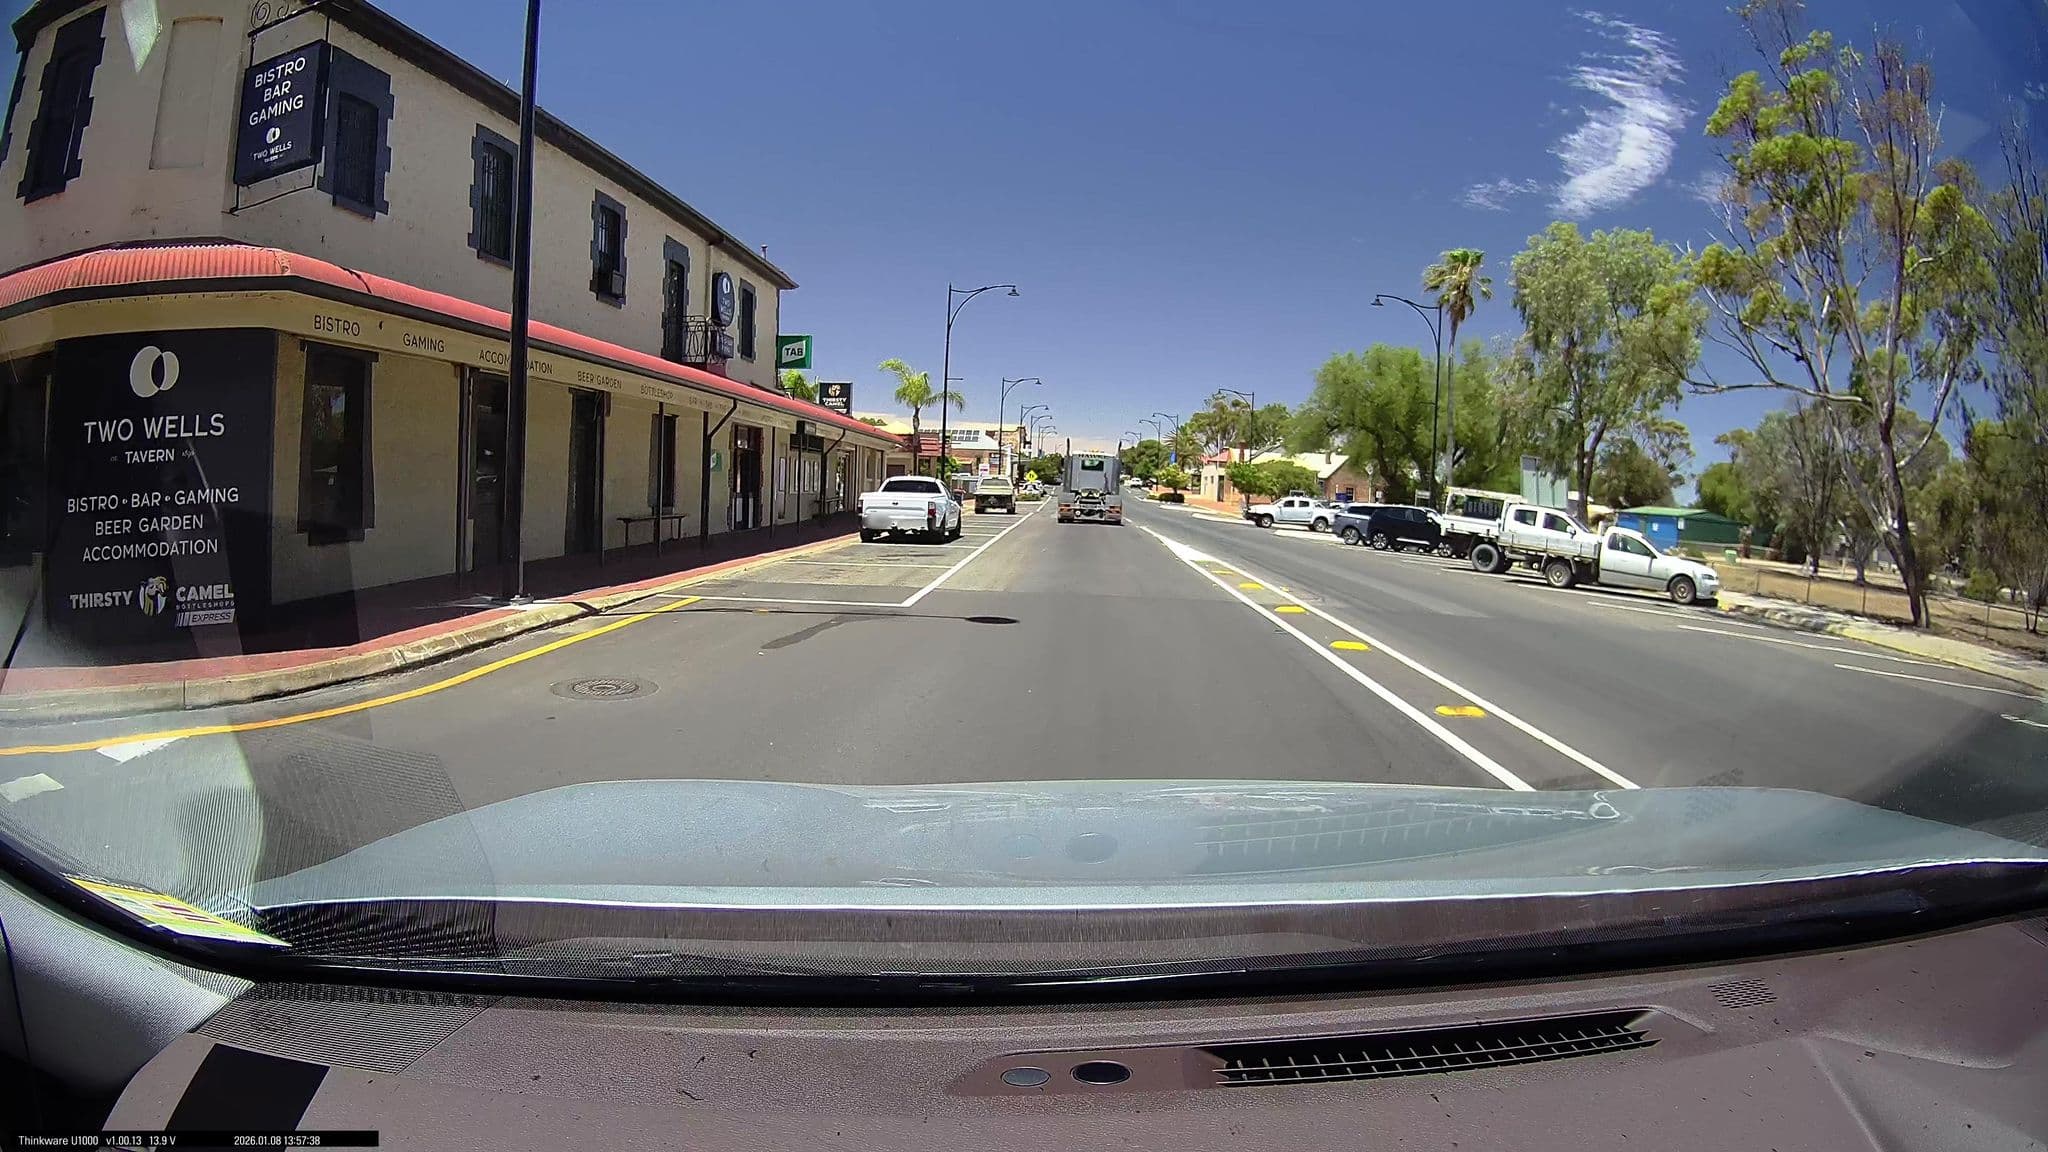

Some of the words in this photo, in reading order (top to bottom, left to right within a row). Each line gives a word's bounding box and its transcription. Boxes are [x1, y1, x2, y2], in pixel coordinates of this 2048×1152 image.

[255, 57, 305, 88] BISTRO
[264, 80, 291, 102] BAR
[249, 94, 304, 126] GAMING
[253, 149, 268, 161] TWO
[269, 141, 292, 155] WELLS
[313, 315, 360, 337] BISTRO
[402, 333, 445, 353] GAMING
[577, 371, 594, 385] BEER
[596, 375, 622, 389] GARDEN
[784, 347, 803, 357] TAB
[83, 418, 134, 444] TWO
[143, 413, 225, 439] WELLS
[125, 449, 175, 464] TAVERN
[67, 495, 119, 513] BISTRO
[131, 491, 161, 508] BAR
[174, 487, 240, 505] GAMING
[95, 519, 132, 536] BEER
[138, 514, 204, 533] GARDEN
[82, 538, 218, 562] ACCOMMODATION
[69, 590, 133, 609] THIRSTY
[175, 584, 234, 602] CAMEL
[175, 600, 235, 610] BOTTLESHOPS
[191, 612, 232, 623] EXPRESS
